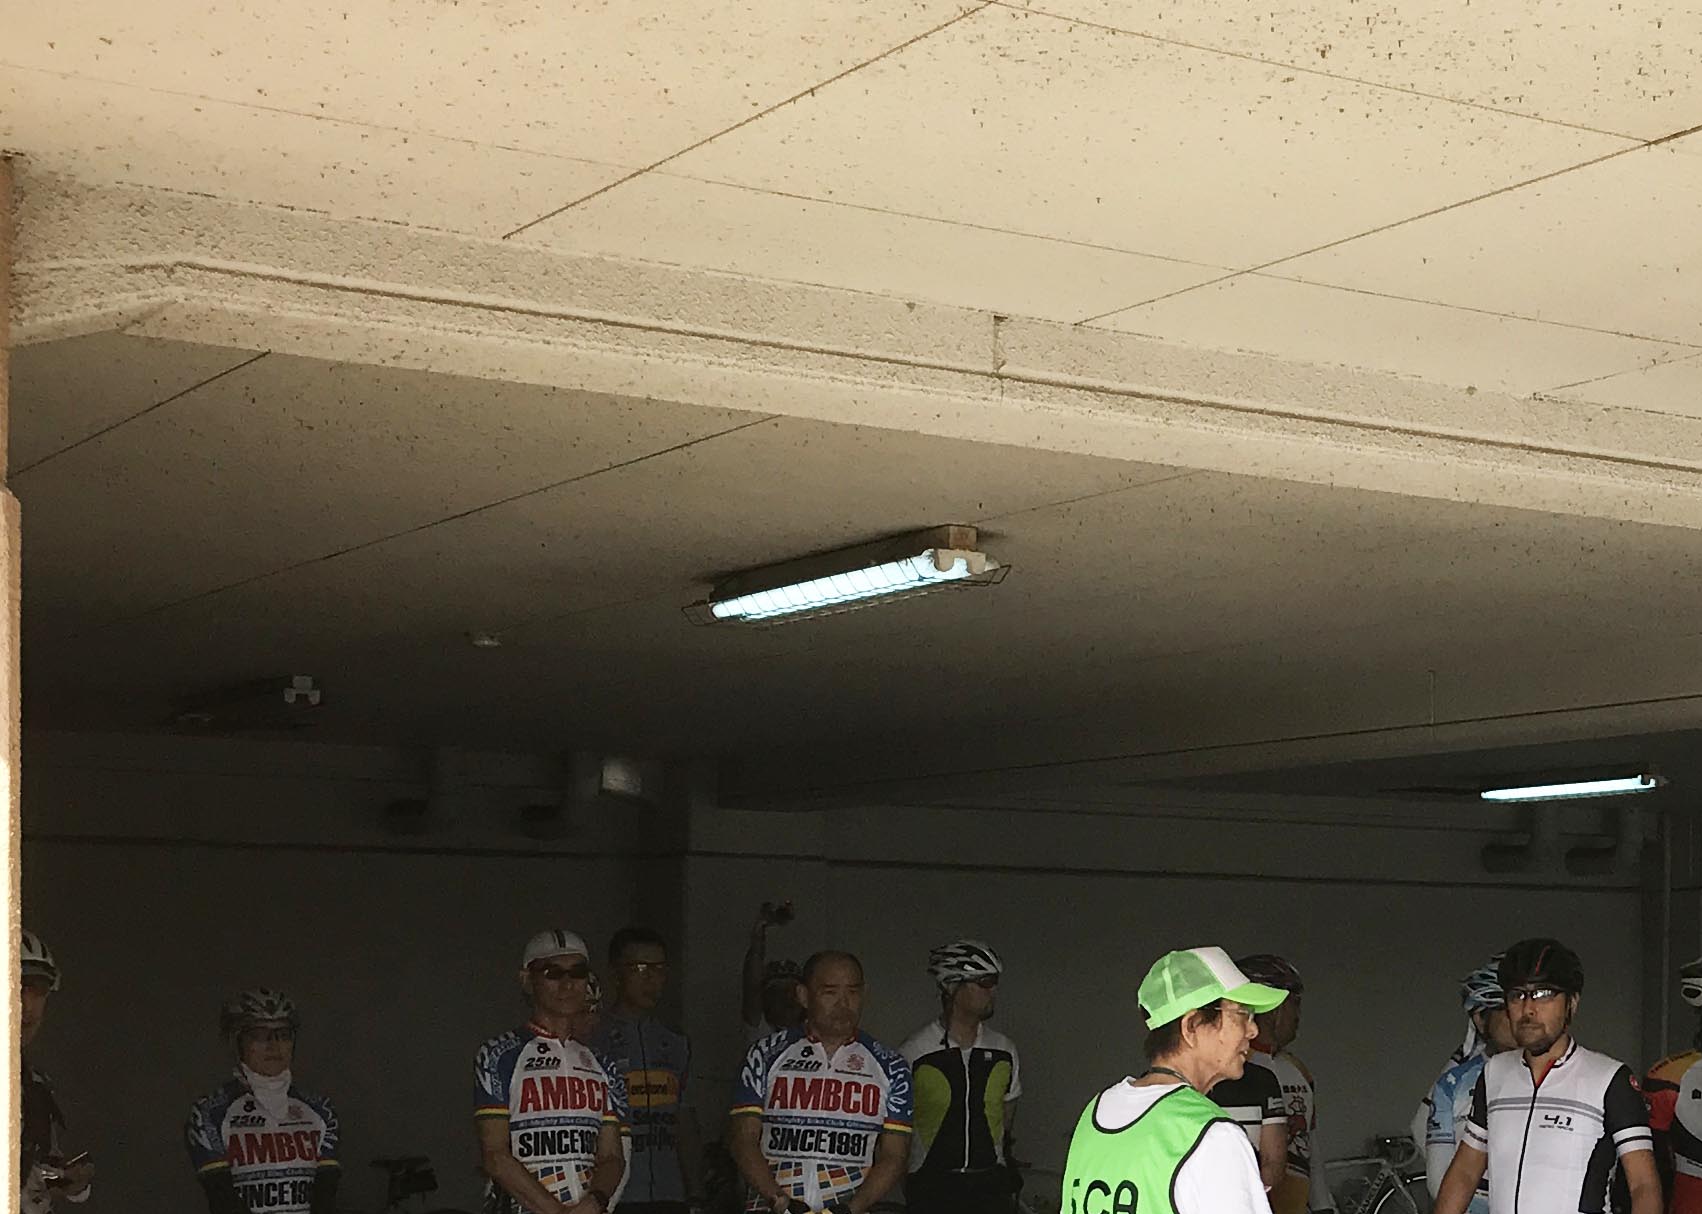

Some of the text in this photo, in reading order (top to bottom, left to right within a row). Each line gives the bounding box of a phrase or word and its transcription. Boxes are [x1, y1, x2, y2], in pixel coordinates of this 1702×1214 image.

[525, 1056, 562, 1068] 25th
[782, 1058, 823, 1069] 25th
[768, 1076, 880, 1117] AMBCO
[1544, 1114, 1571, 1126] 4.1
[769, 1127, 870, 1157] SINCE1991
